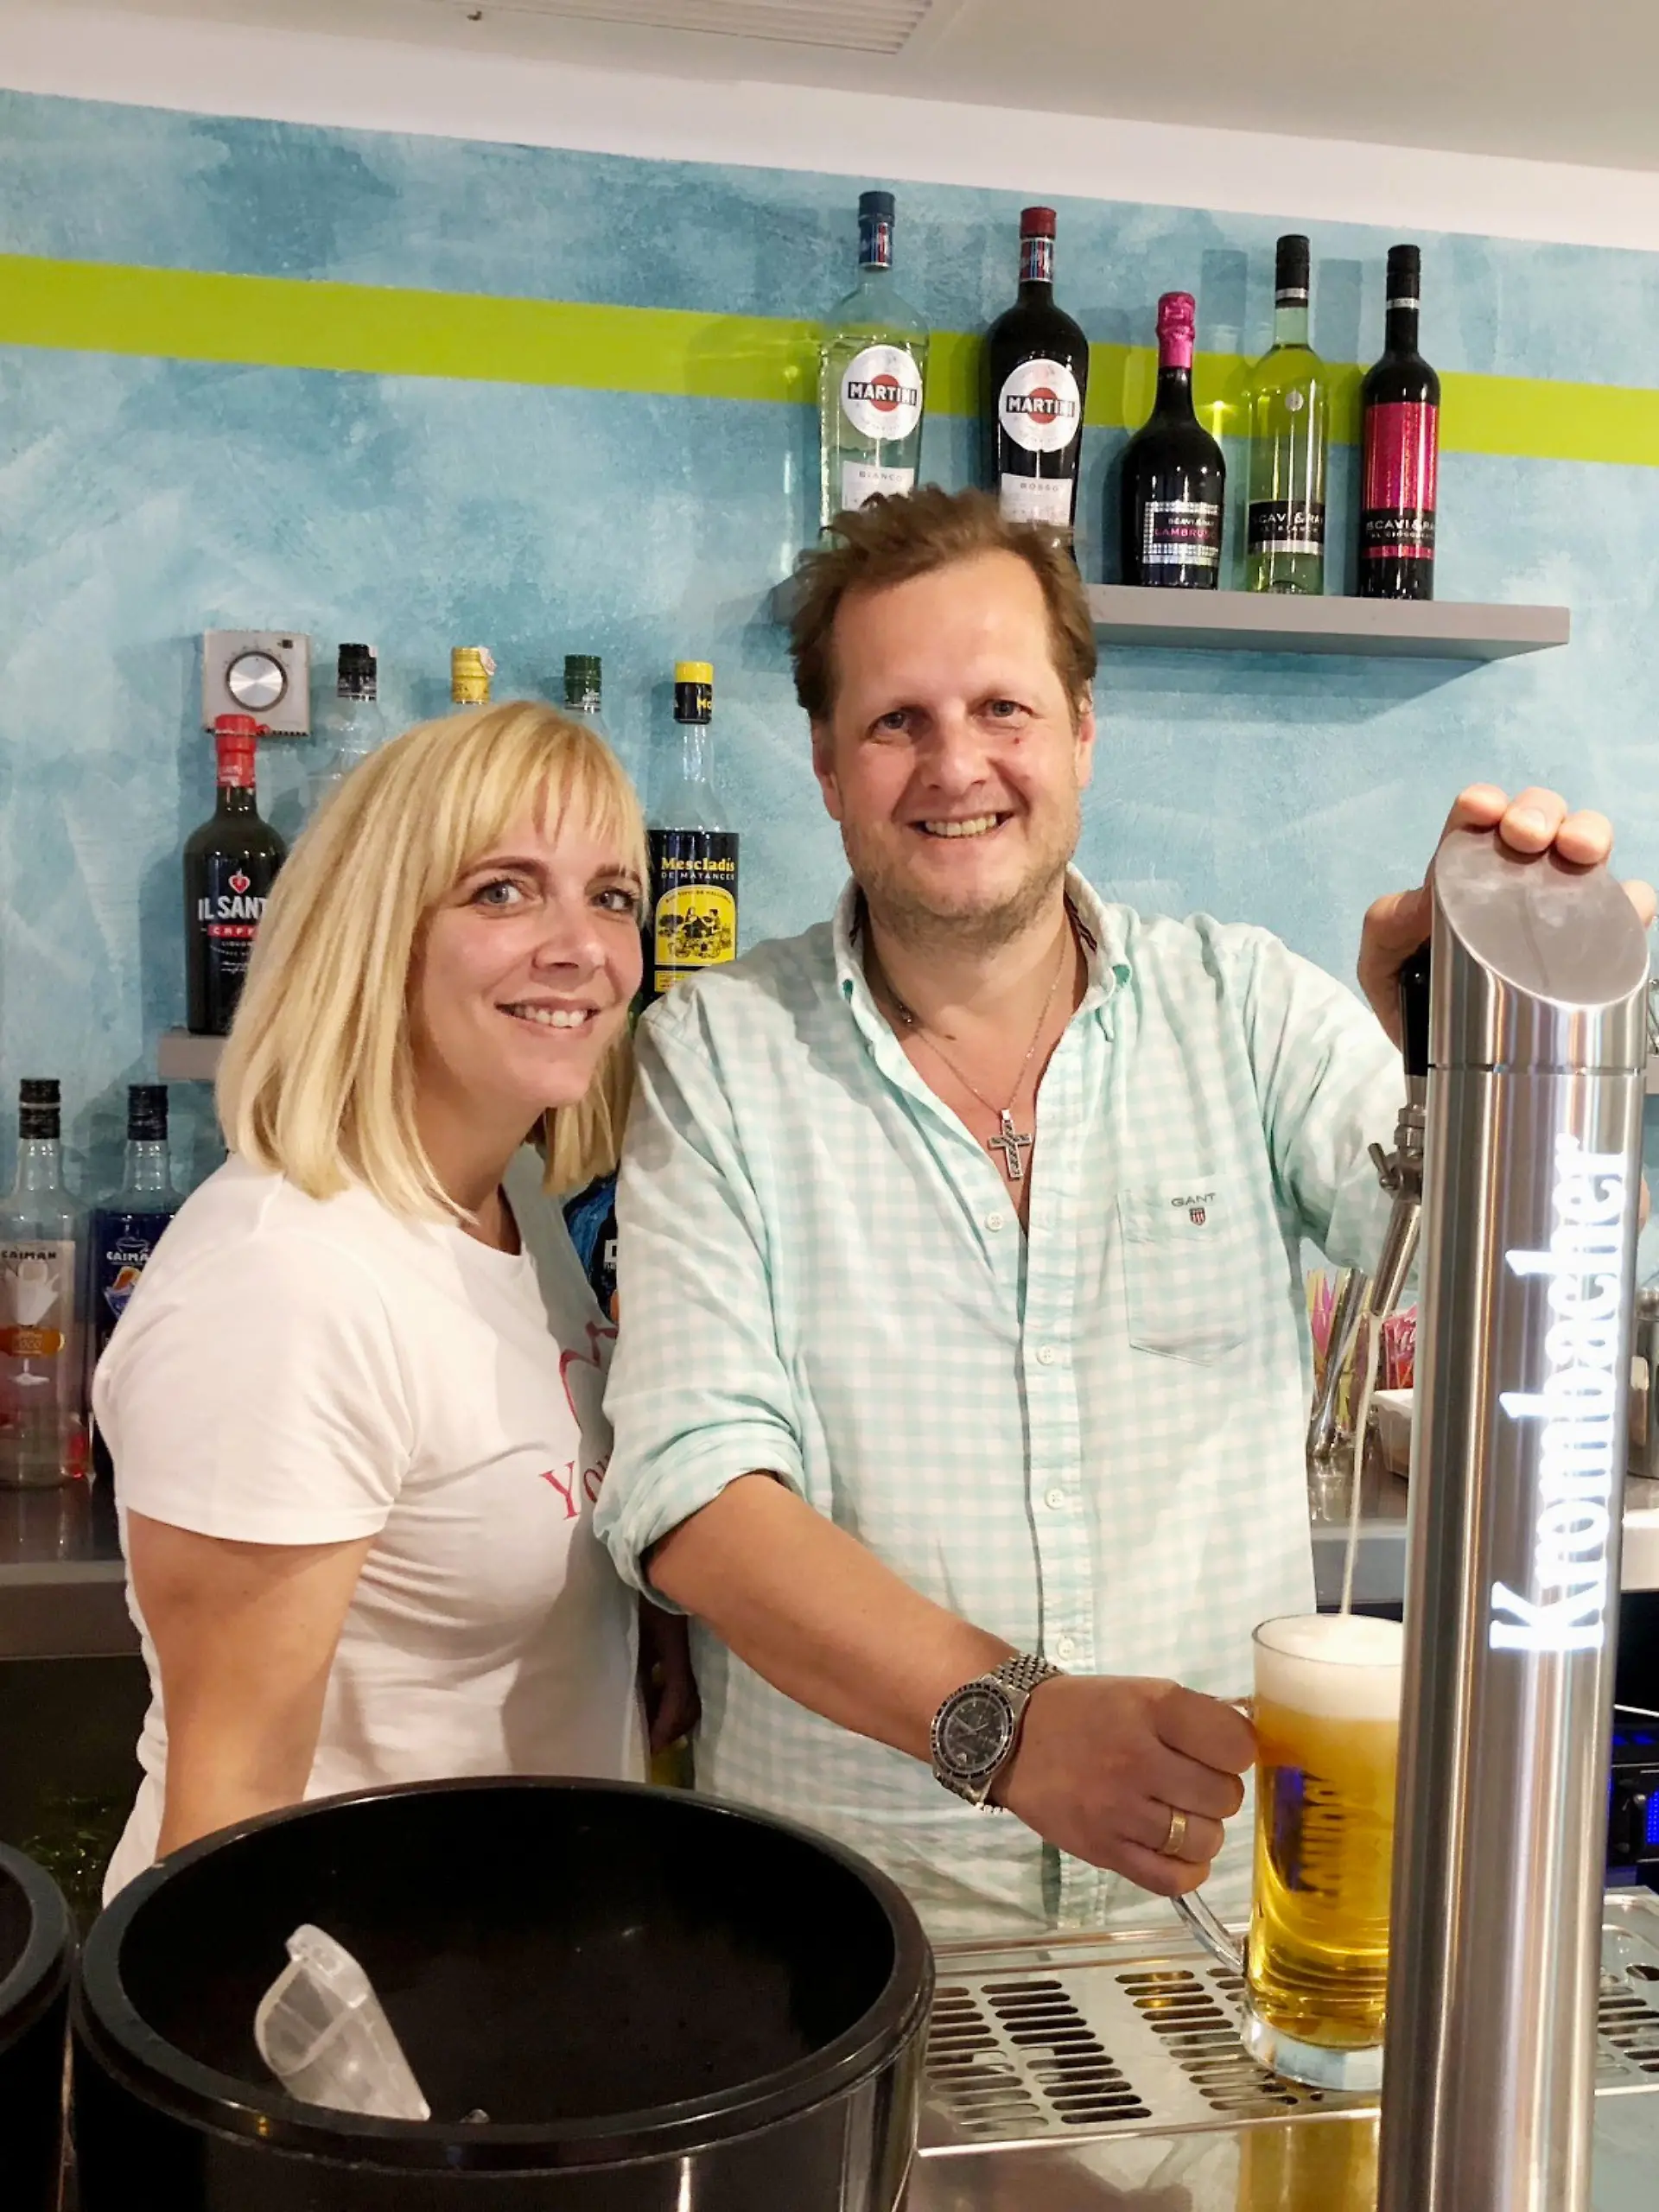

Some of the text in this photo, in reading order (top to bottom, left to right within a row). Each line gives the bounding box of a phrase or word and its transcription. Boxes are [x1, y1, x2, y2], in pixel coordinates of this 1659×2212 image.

[849, 383, 917, 406] MARTINI
[1008, 396, 1075, 417] MARTINI
[198, 895, 267, 921] IL SANT
[213, 926, 255, 936] CAFF
[1171, 1192, 1216, 1207] GANT
[106, 1251, 149, 1262] CAIMA
[1490, 1133, 1628, 1650] Krombacher
